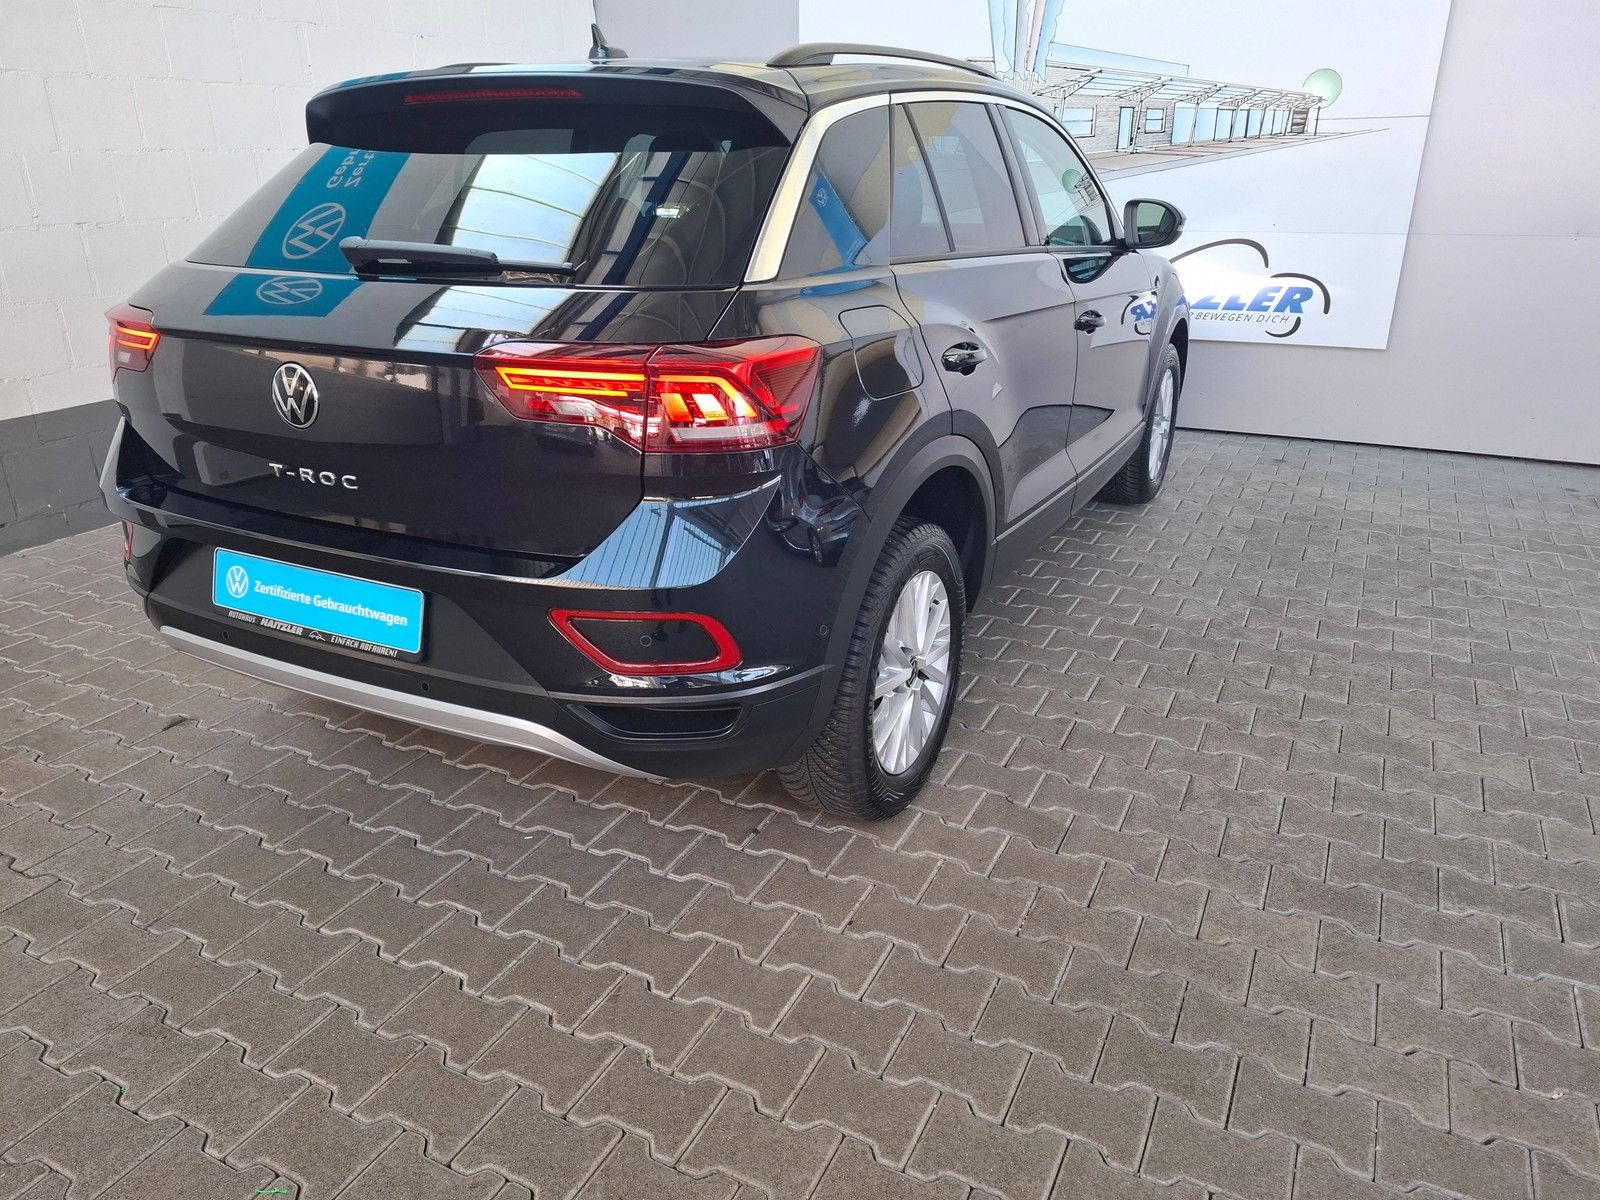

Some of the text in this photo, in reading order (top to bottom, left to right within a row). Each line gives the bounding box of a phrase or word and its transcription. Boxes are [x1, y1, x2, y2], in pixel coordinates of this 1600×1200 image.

[1195, 311, 1254, 323] BEWEGEN
[1256, 314, 1290, 324] DICH
[268, 462, 359, 490] T-ROC
[253, 580, 408, 627] Zertifizierte Gebrauchtwagen
[228, 610, 398, 658] AUTOHAUS HAITZLER EINFACH ABFAHREN!
